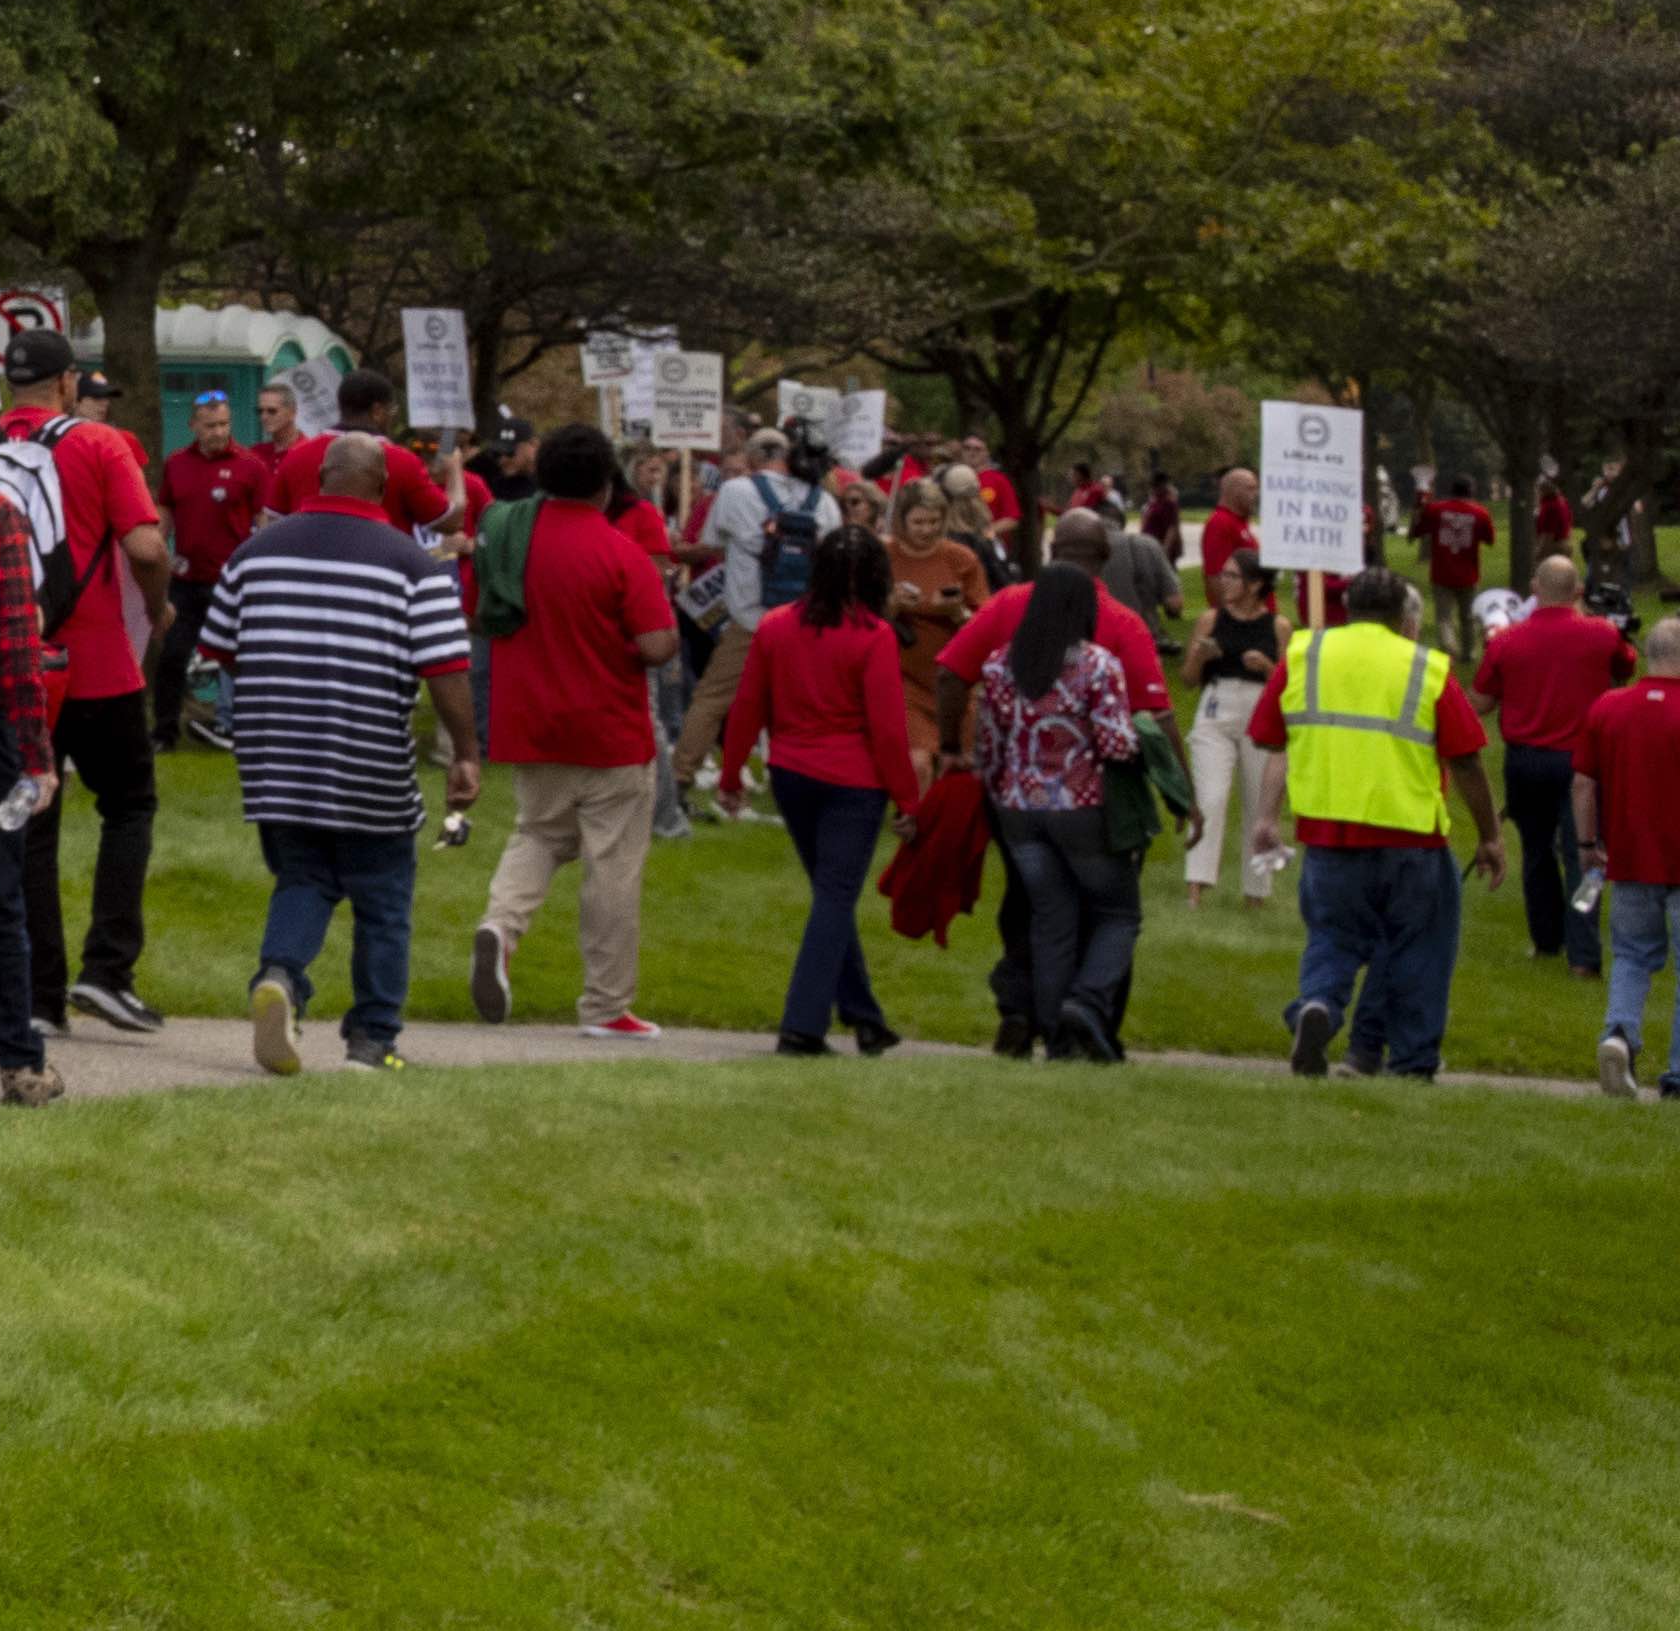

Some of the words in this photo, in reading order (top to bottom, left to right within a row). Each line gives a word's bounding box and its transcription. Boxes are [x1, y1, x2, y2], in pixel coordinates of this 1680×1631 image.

[1277, 499, 1302, 517] IN
[1310, 502, 1349, 523] BAD
[1282, 525, 1343, 548] FAITH
